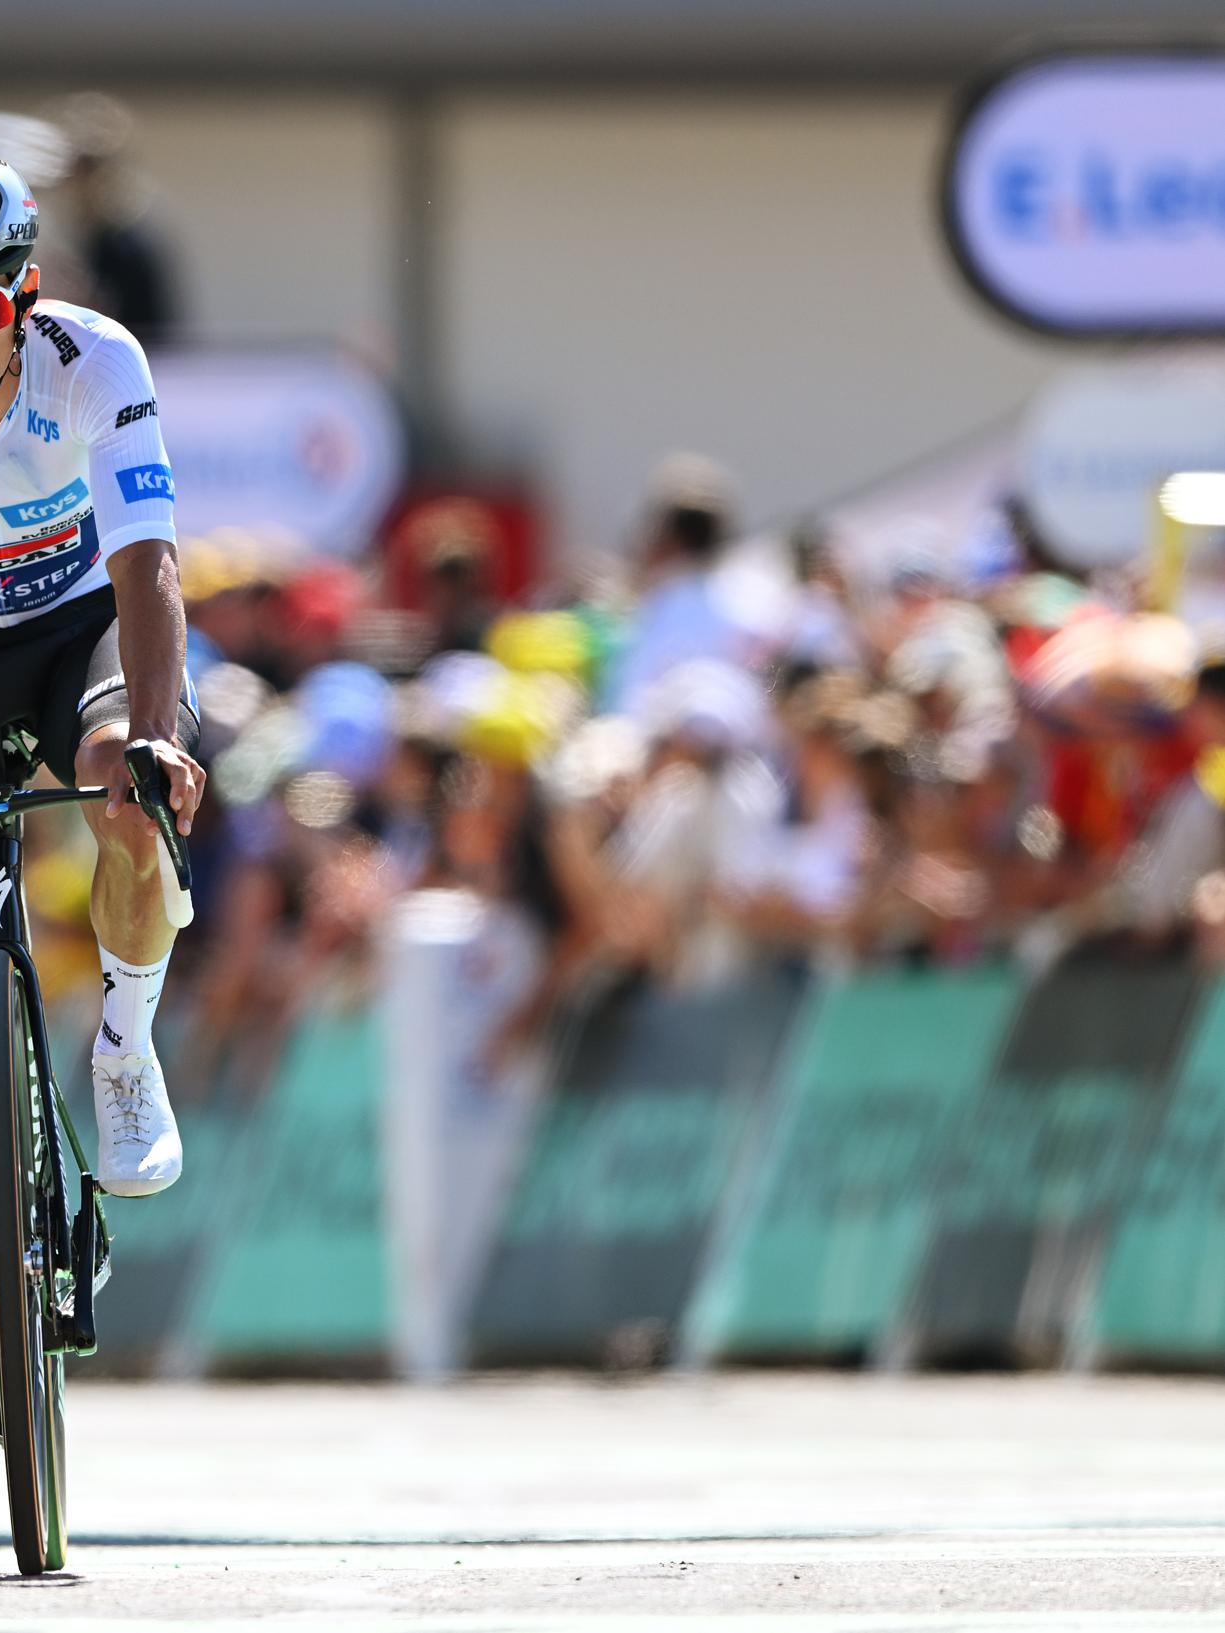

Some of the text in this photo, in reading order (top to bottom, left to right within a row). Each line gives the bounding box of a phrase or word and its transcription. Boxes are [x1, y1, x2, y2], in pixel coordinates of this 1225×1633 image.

[27, 408, 60, 443] Krys
[115, 396, 158, 429] Sant
[134, 471, 175, 495] Kry
[18, 492, 78, 521] Krys
